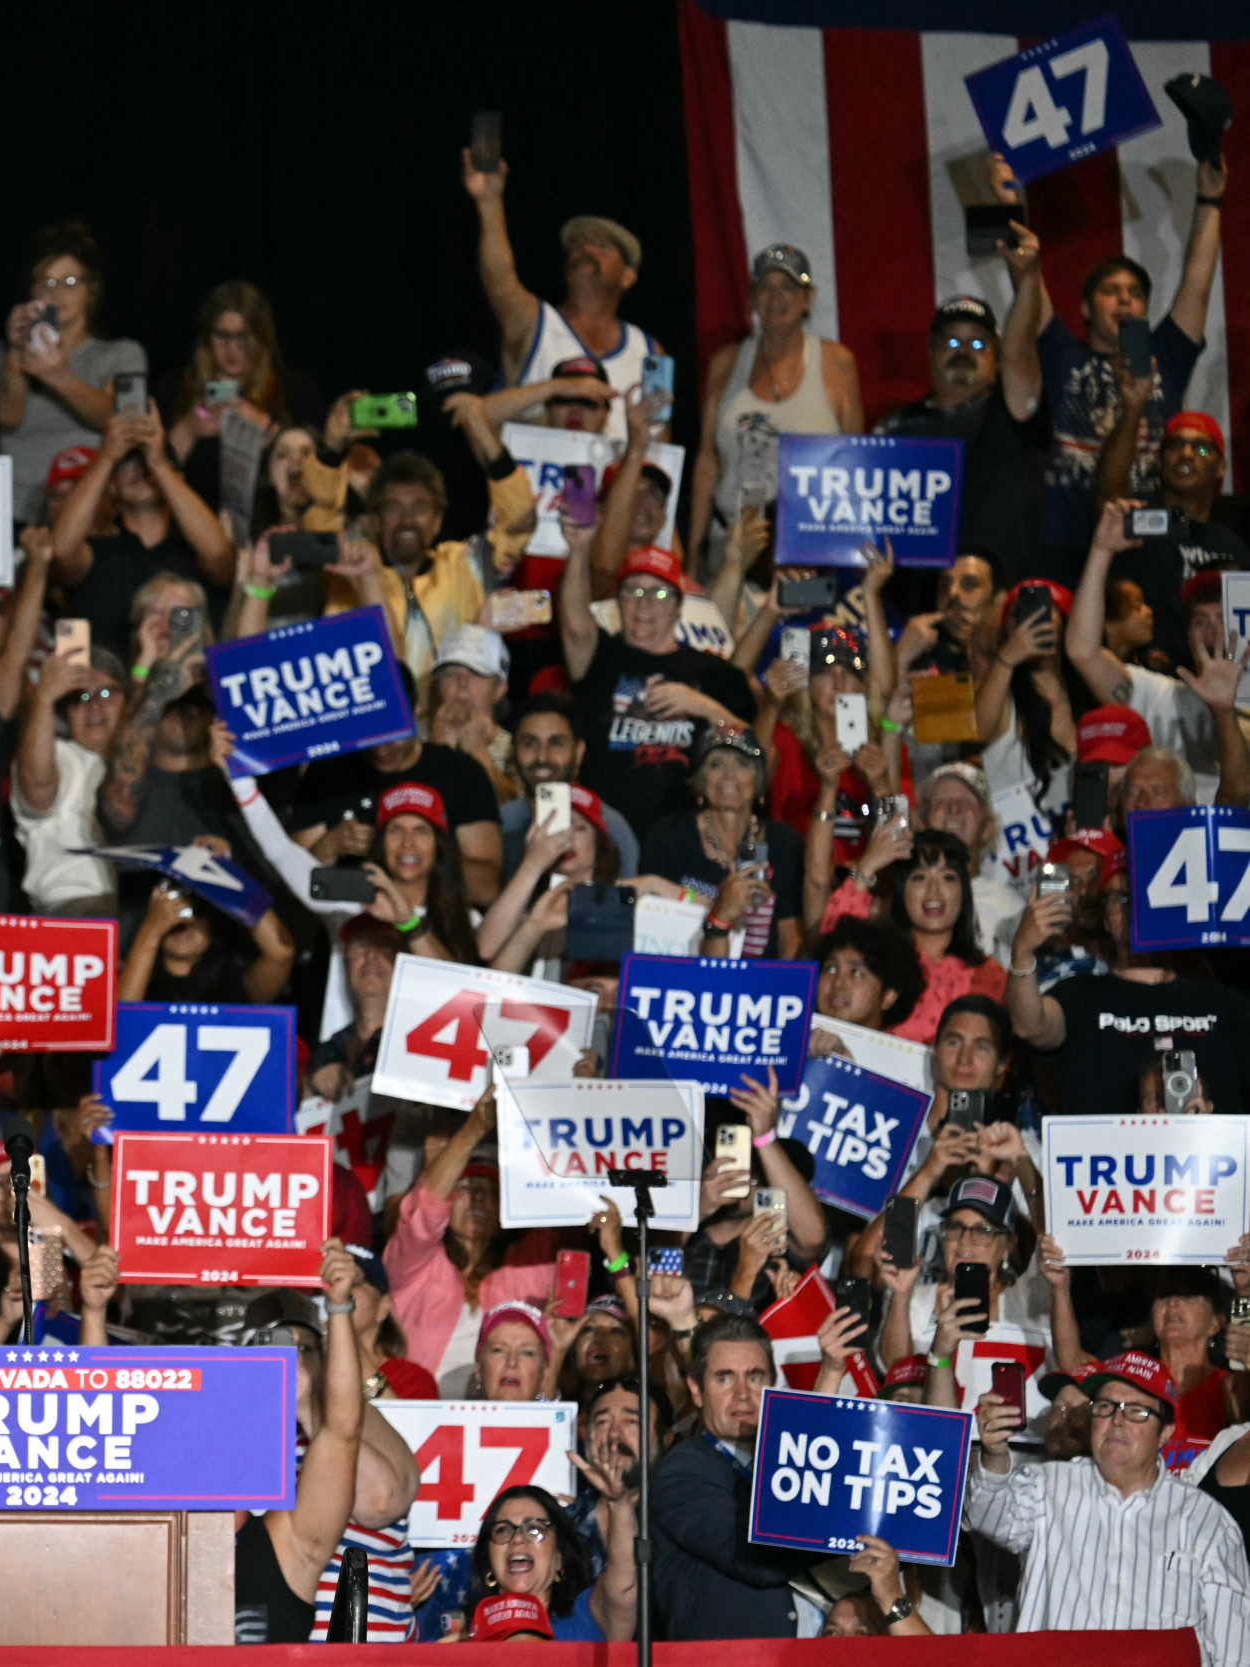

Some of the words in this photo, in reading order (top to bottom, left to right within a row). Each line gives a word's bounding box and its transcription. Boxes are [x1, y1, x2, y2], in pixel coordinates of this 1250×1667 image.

[1002, 37, 1109, 150] 47
[789, 466, 952, 500] TRUMP
[808, 497, 932, 526] VANCE
[220, 641, 384, 707] TRUMP
[243, 676, 376, 728] VANCE
[630, 986, 804, 1029] TRUMP
[406, 990, 571, 1082] 47
[648, 1020, 782, 1054] VANCE
[110, 1024, 271, 1123] 47
[701, 1082, 728, 1094] 024
[515, 1117, 686, 1150] TRUMP
[823, 1092, 900, 1149] TAX
[536, 1150, 669, 1177] VANCE
[807, 1120, 892, 1180] TIPS
[1056, 1154, 1238, 1187] TRUMP
[126, 1170, 320, 1208] TRUMP
[1076, 1189, 1216, 1215] VANCE
[147, 1206, 297, 1238] VANCE
[1067, 1218, 1095, 1227] MAKE
[1098, 1218, 1144, 1227] AMERICA
[135, 1236, 168, 1247] MAKE
[171, 1237, 223, 1248] AMERICA
[225, 1238, 263, 1249] GREAT
[265, 1239, 307, 1250] AGAIN!
[1126, 1250, 1160, 1260] 2024
[200, 1270, 239, 1282] 2024
[74, 1369, 108, 1389] TO
[115, 1369, 192, 1389] 88022
[414, 1425, 550, 1521] 47
[778, 1431, 840, 1470] NO
[852, 1440, 943, 1484] TAX
[47, 1472, 92, 1483] GREAT
[96, 1472, 145, 1483] AGAIN!
[771, 1467, 832, 1506] ON
[844, 1475, 943, 1519] TIPS
[6, 1485, 78, 1506] 2024
[452, 1534, 478, 1543] 202
[828, 1536, 865, 1551] 2024
